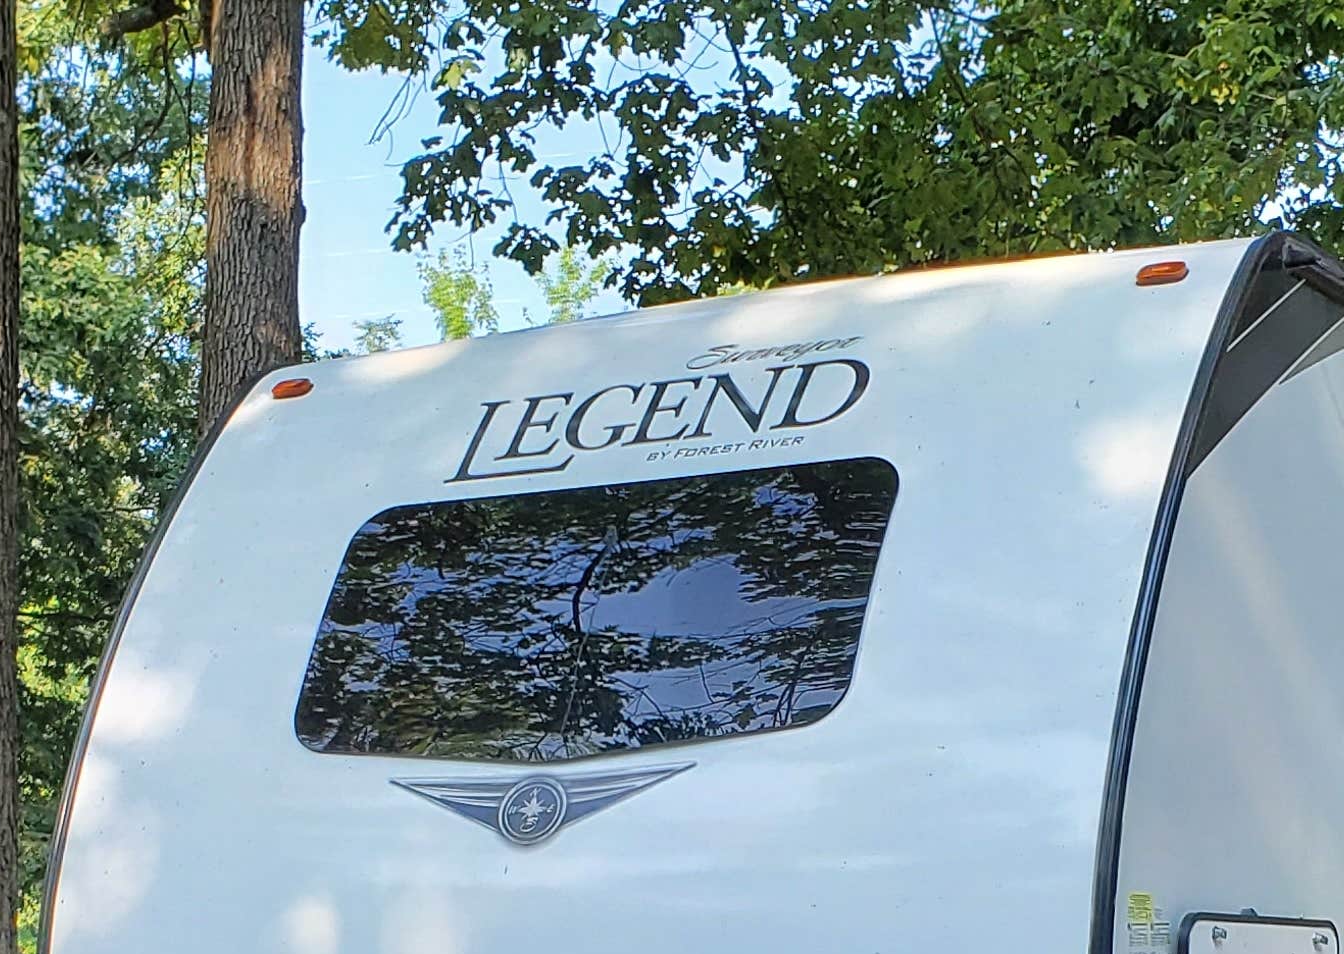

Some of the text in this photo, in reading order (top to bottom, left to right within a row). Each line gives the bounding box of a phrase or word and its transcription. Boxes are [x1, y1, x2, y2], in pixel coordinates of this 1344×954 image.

[444, 359, 871, 484] LEGEND
[646, 436, 805, 462] BY FOREST RIVER
